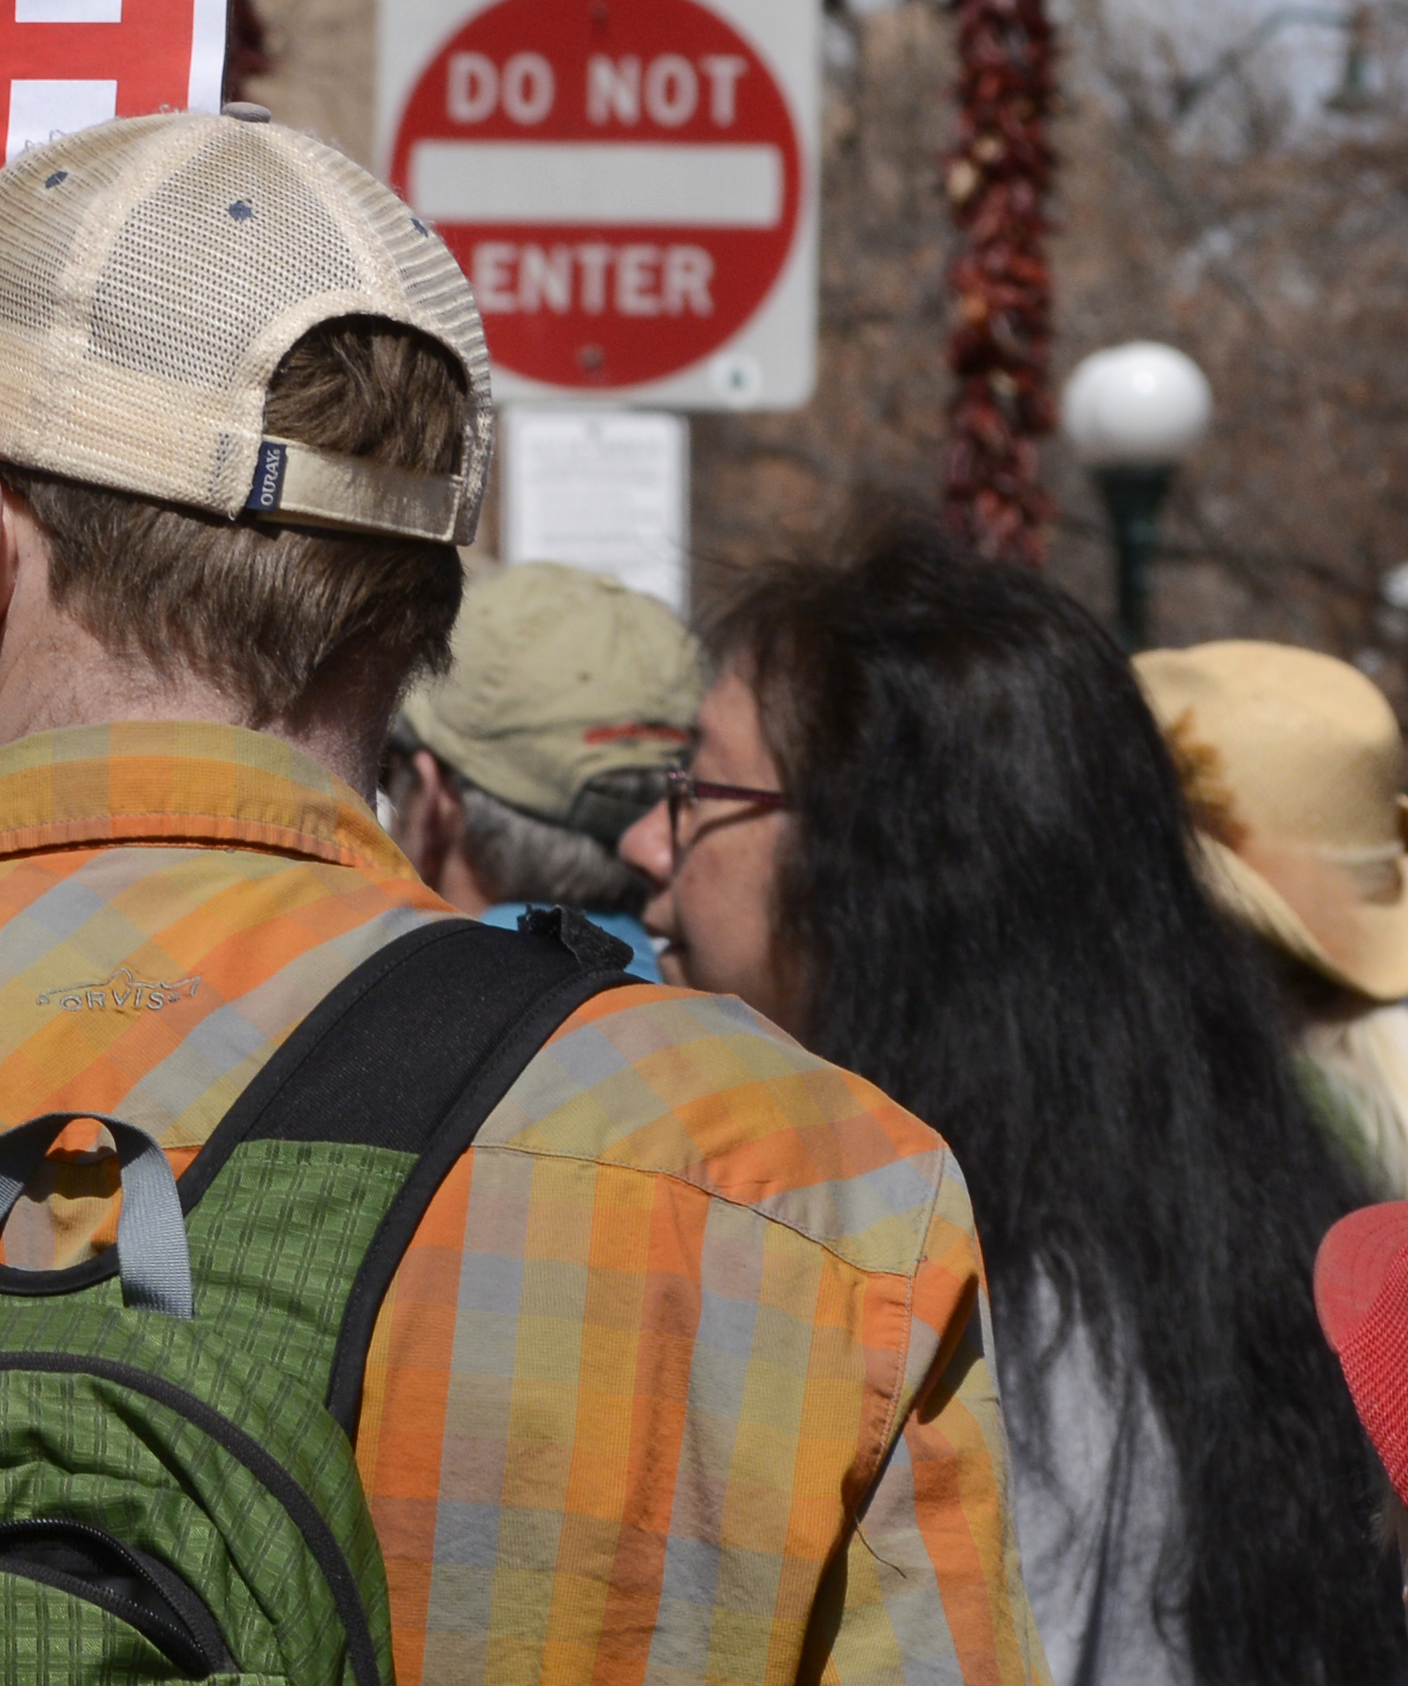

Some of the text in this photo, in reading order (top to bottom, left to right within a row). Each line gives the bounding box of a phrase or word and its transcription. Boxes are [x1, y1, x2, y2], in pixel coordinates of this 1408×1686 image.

[446, 51, 749, 129] DO NOT
[472, 241, 716, 318] ENTER
[260, 449, 281, 506] OURAY
[60, 988, 167, 1011] ORVIS
